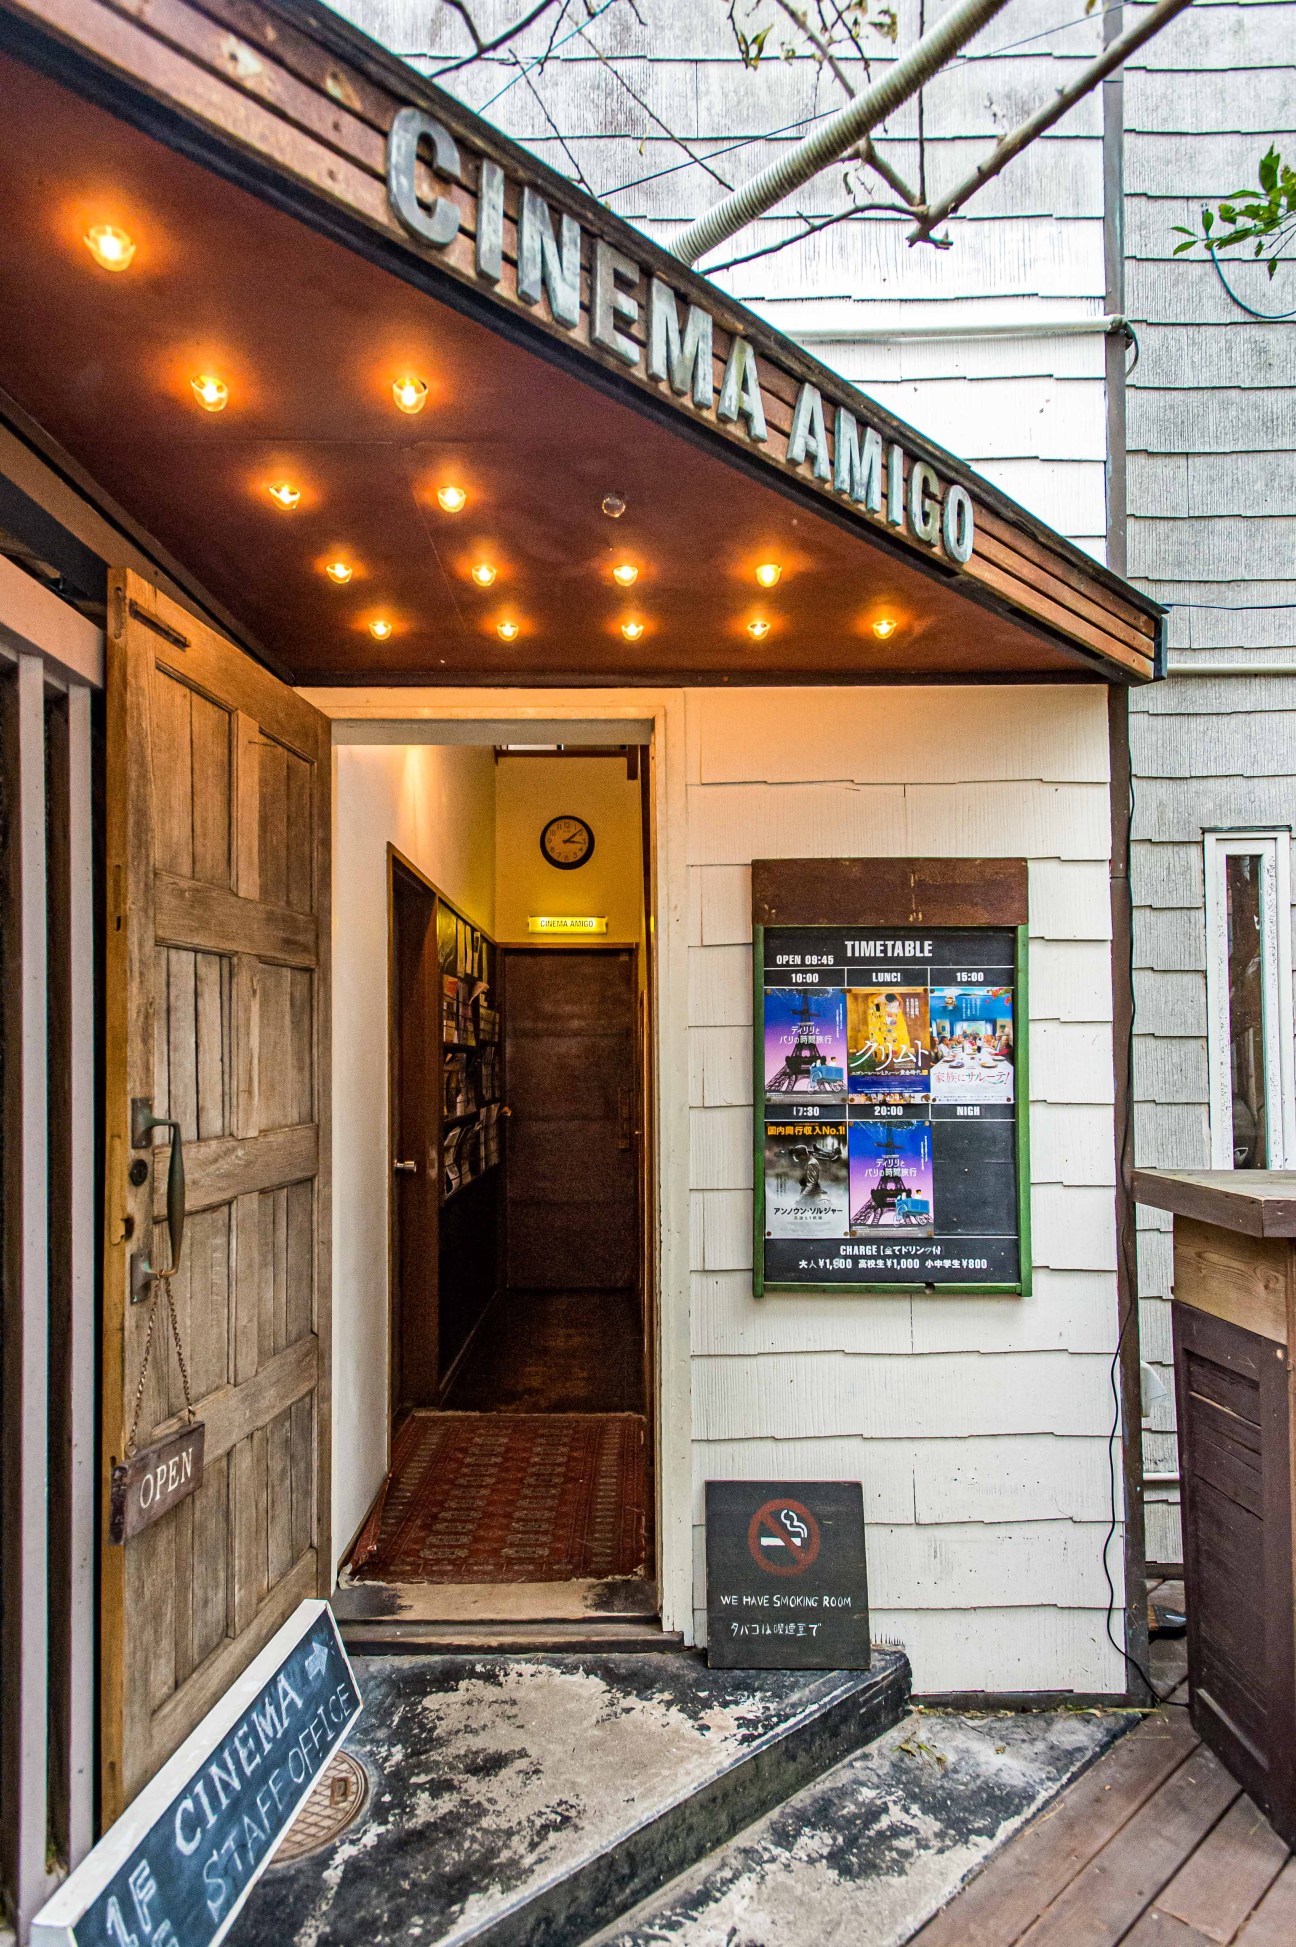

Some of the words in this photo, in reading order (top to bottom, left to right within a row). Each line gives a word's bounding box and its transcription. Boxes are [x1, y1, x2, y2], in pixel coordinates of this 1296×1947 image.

[387, 107, 768, 443] CINEMA
[787, 382, 974, 563] AMIGO
[844, 940, 933, 957] TIMETABLE
[776, 955, 802, 965] OPEN
[805, 955, 835, 965] 09:45
[791, 973, 819, 983] 10:00
[956, 972, 985, 982] 15:00
[849, 1040, 929, 1071] クリムト
[874, 1106, 903, 1116] 20:00
[840, 1245, 878, 1256] CHARGE
[140, 1447, 193, 1509] OPEN
[720, 1595, 739, 1606] WE
[743, 1595, 770, 1607] HAVE
[773, 1594, 819, 1608] SMOKING
[822, 1595, 852, 1608] ROOM
[174, 1674, 304, 1857] CINEMA
[203, 1768, 284, 1925] STAFF
[287, 1683, 352, 1784] OFFICE
